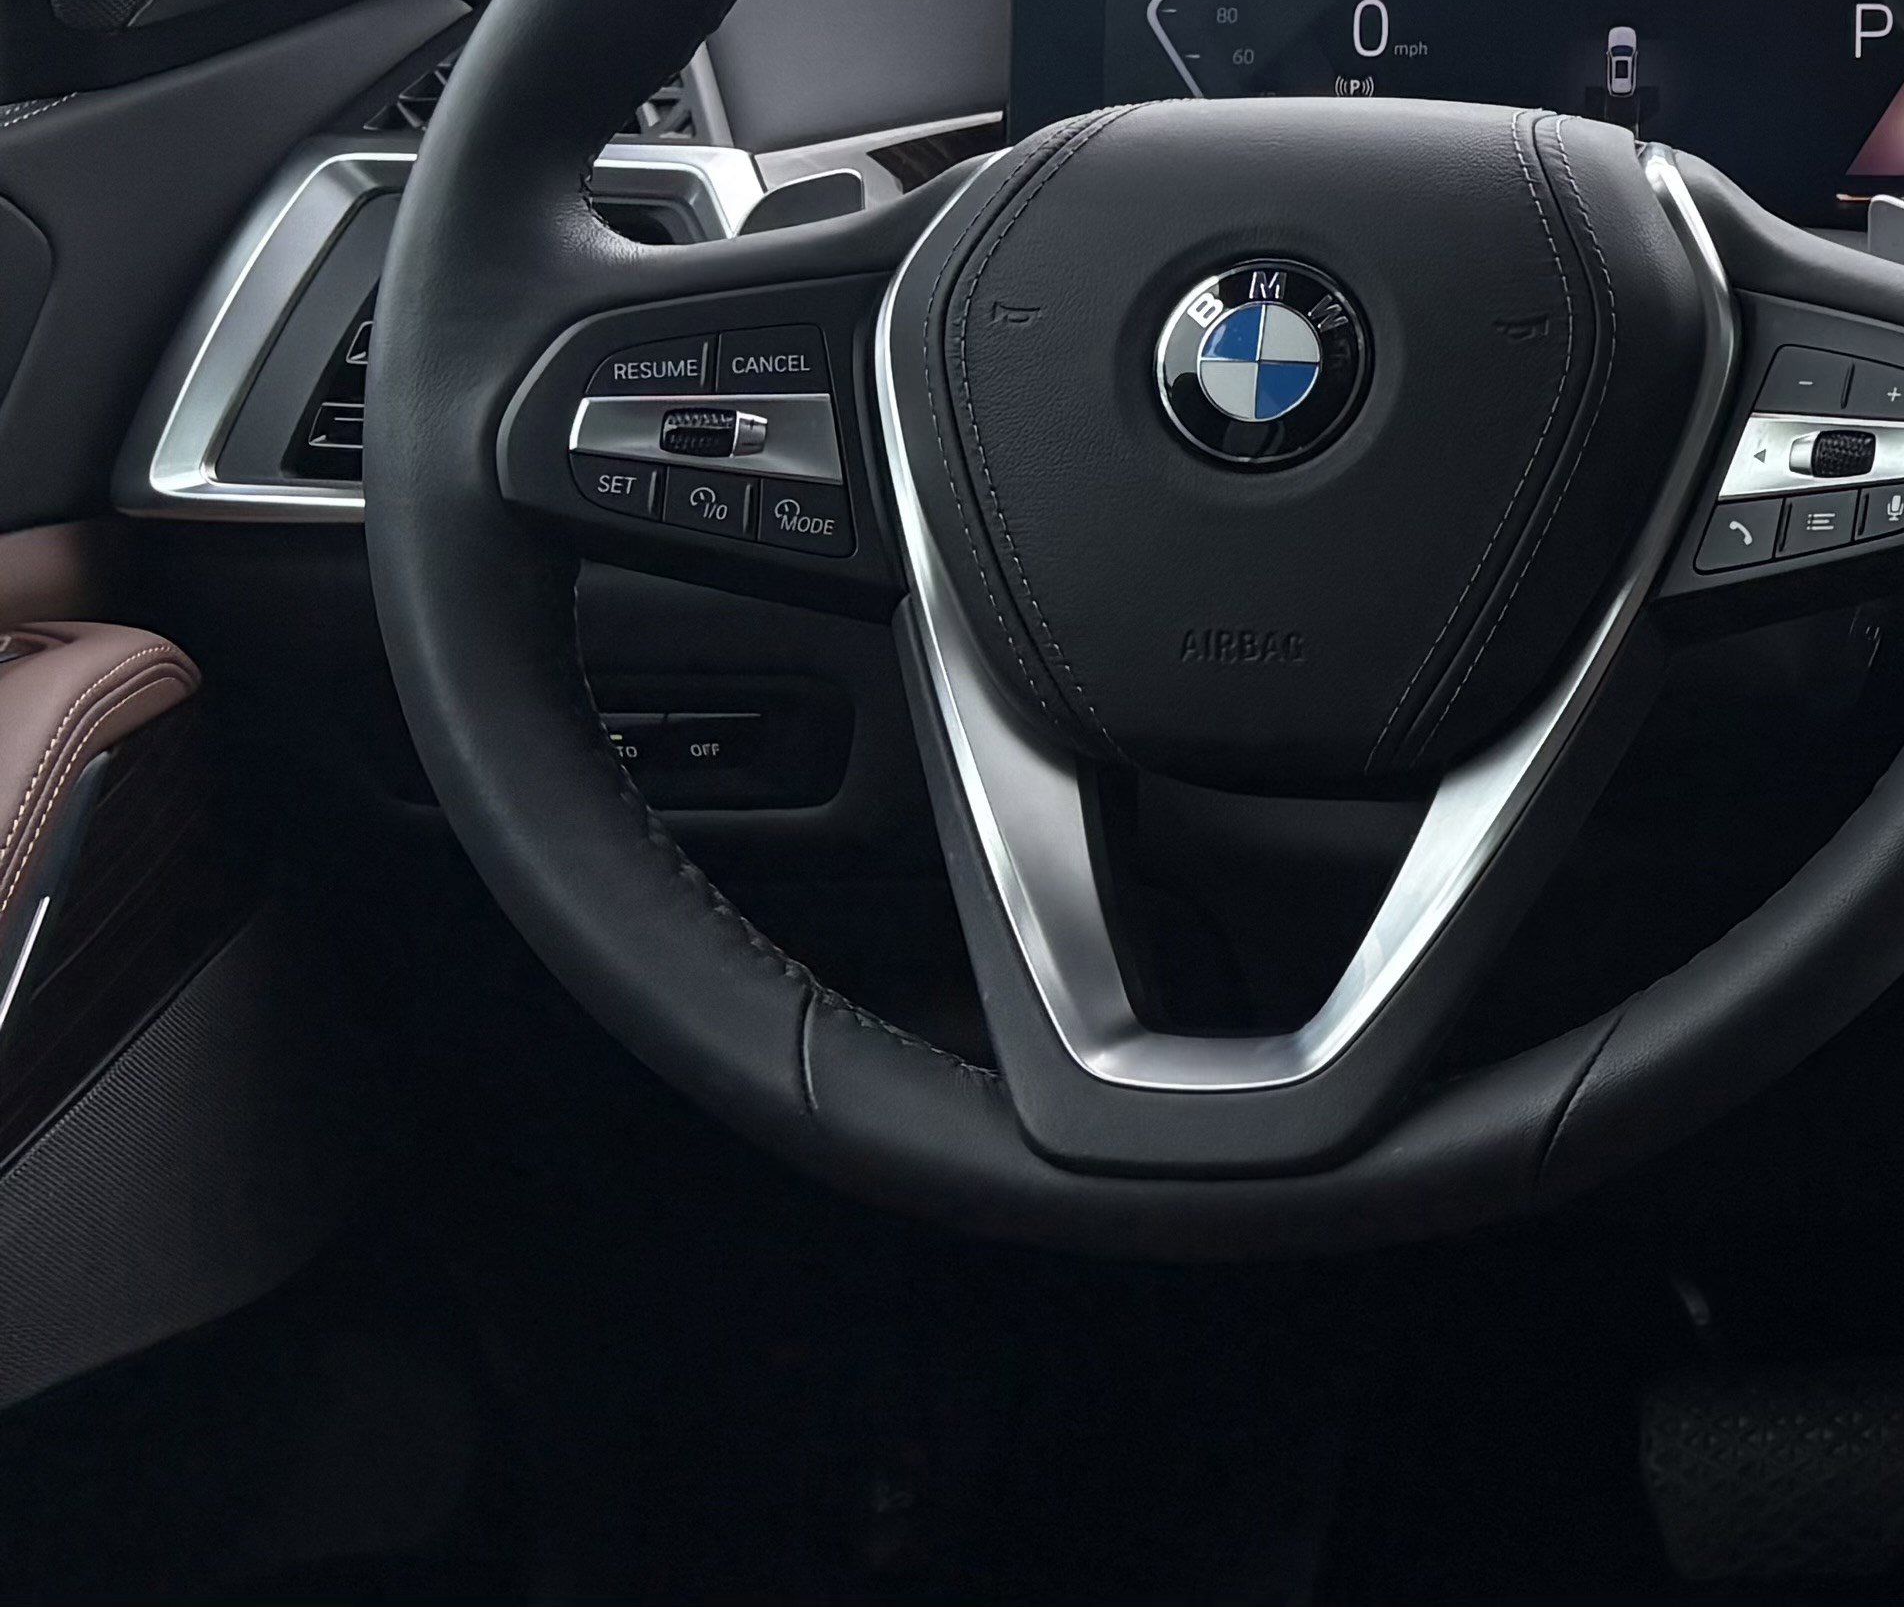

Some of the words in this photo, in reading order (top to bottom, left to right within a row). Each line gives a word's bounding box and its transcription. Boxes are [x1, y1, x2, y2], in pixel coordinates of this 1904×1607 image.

[1216, 6, 1239, 24] 80
[1855, 3, 1894, 59] P
[1232, 48, 1255, 66] 60
[1394, 40, 1429, 58] mph
[1186, 269, 1349, 332] BMW
[613, 358, 699, 382] RESUME
[732, 354, 811, 375] CANCEL
[597, 474, 638, 495] SET
[780, 514, 836, 537] MODE
[1179, 628, 1308, 663] AIRBAG
[690, 743, 721, 759] OFF
